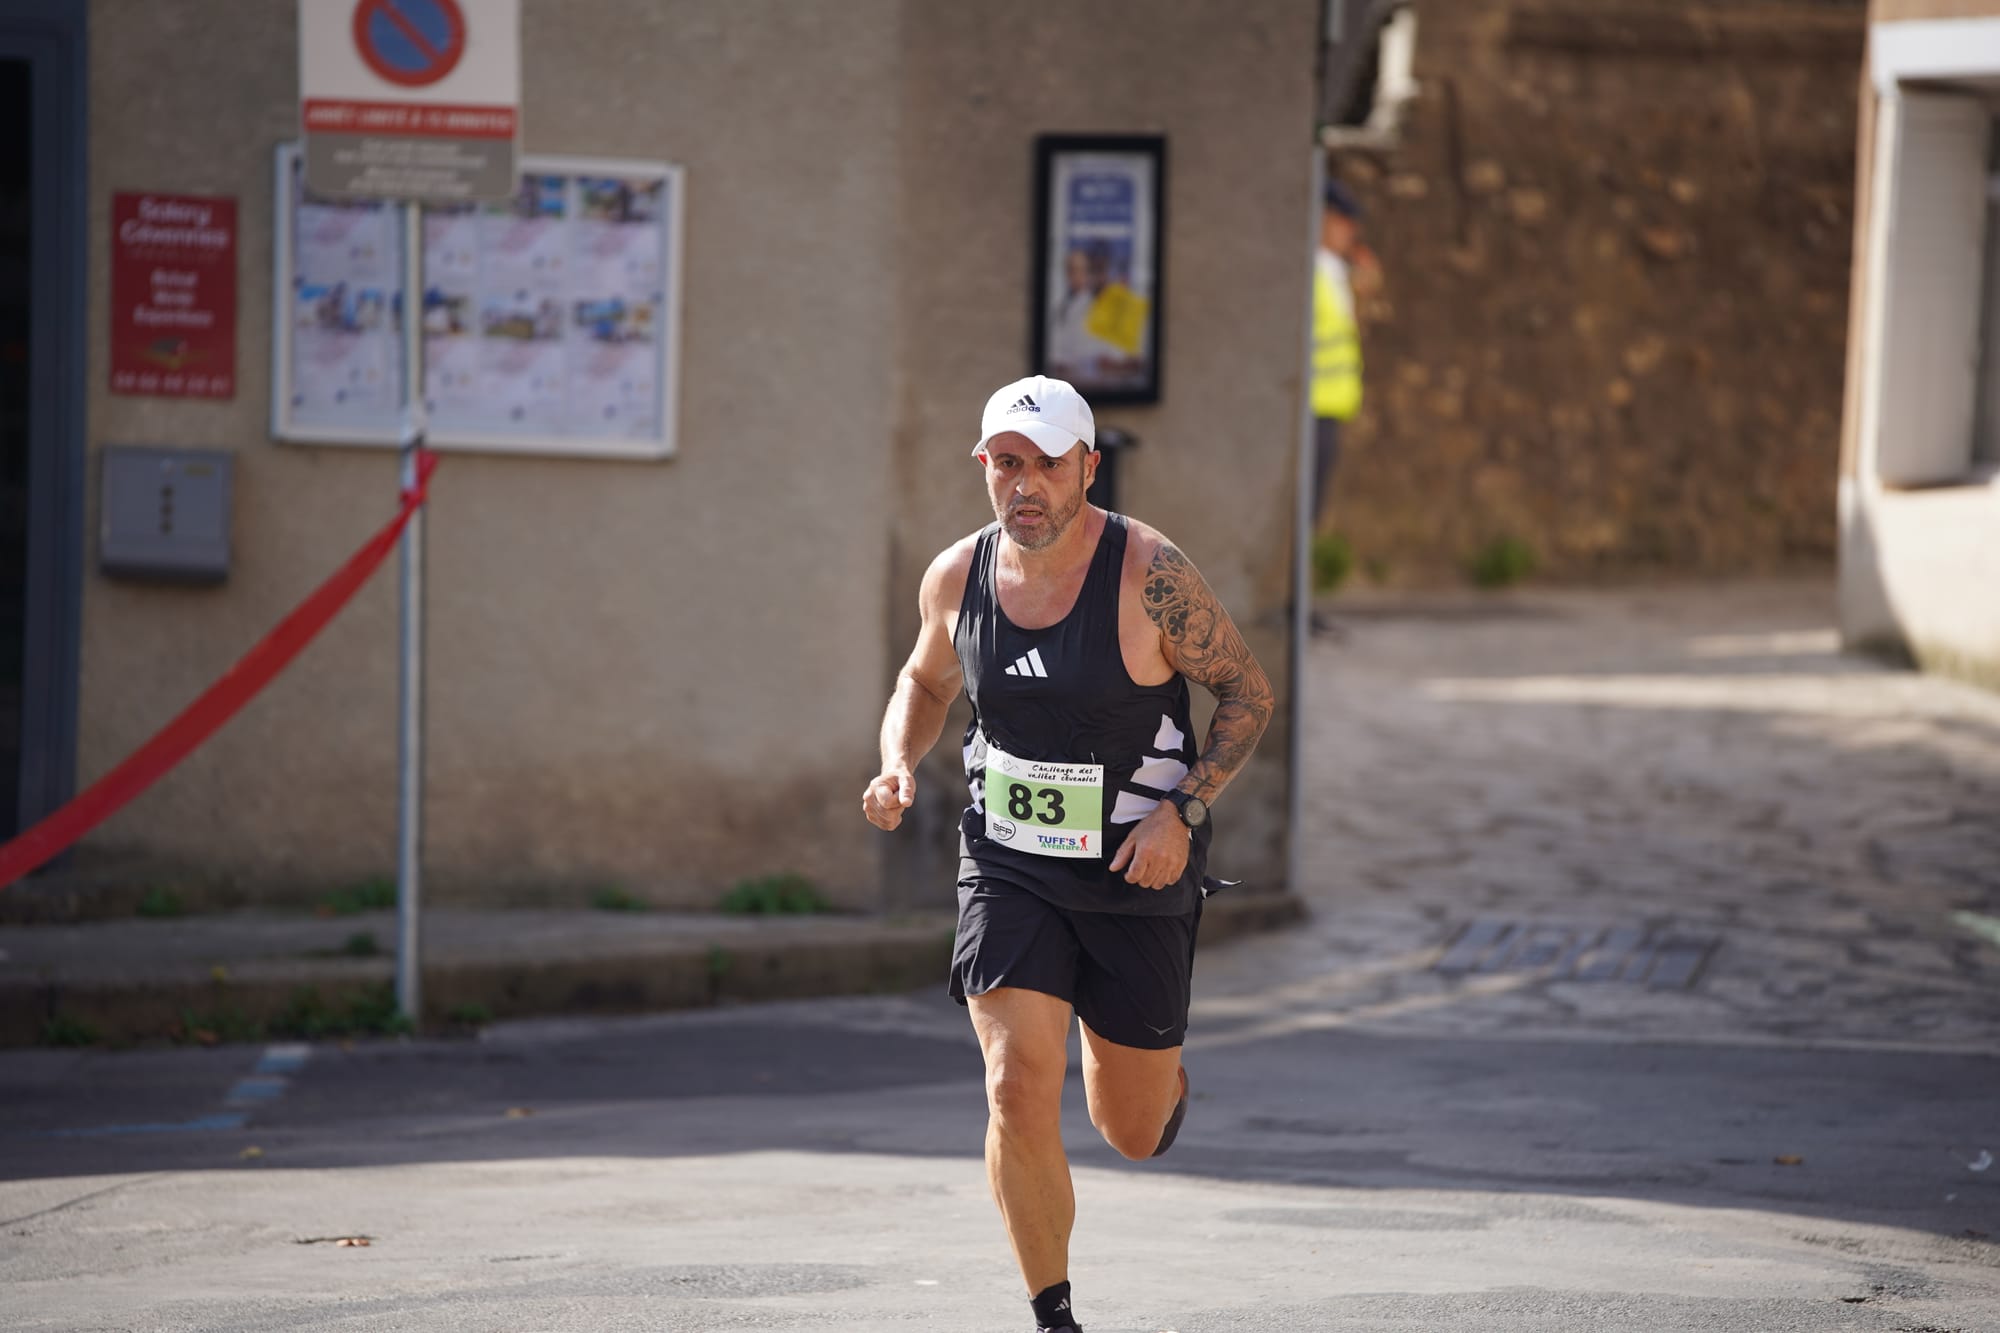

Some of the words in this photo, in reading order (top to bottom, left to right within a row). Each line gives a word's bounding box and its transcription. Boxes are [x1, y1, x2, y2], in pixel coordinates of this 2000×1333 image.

[1006, 405, 1041, 415] adidas
[1032, 764, 1074, 775] Challenge
[1028, 773, 1057, 781] vallées
[1008, 783, 1066, 825] 83
[1037, 835, 1076, 845] TUFF'S
[1041, 842, 1080, 851] Aventure
